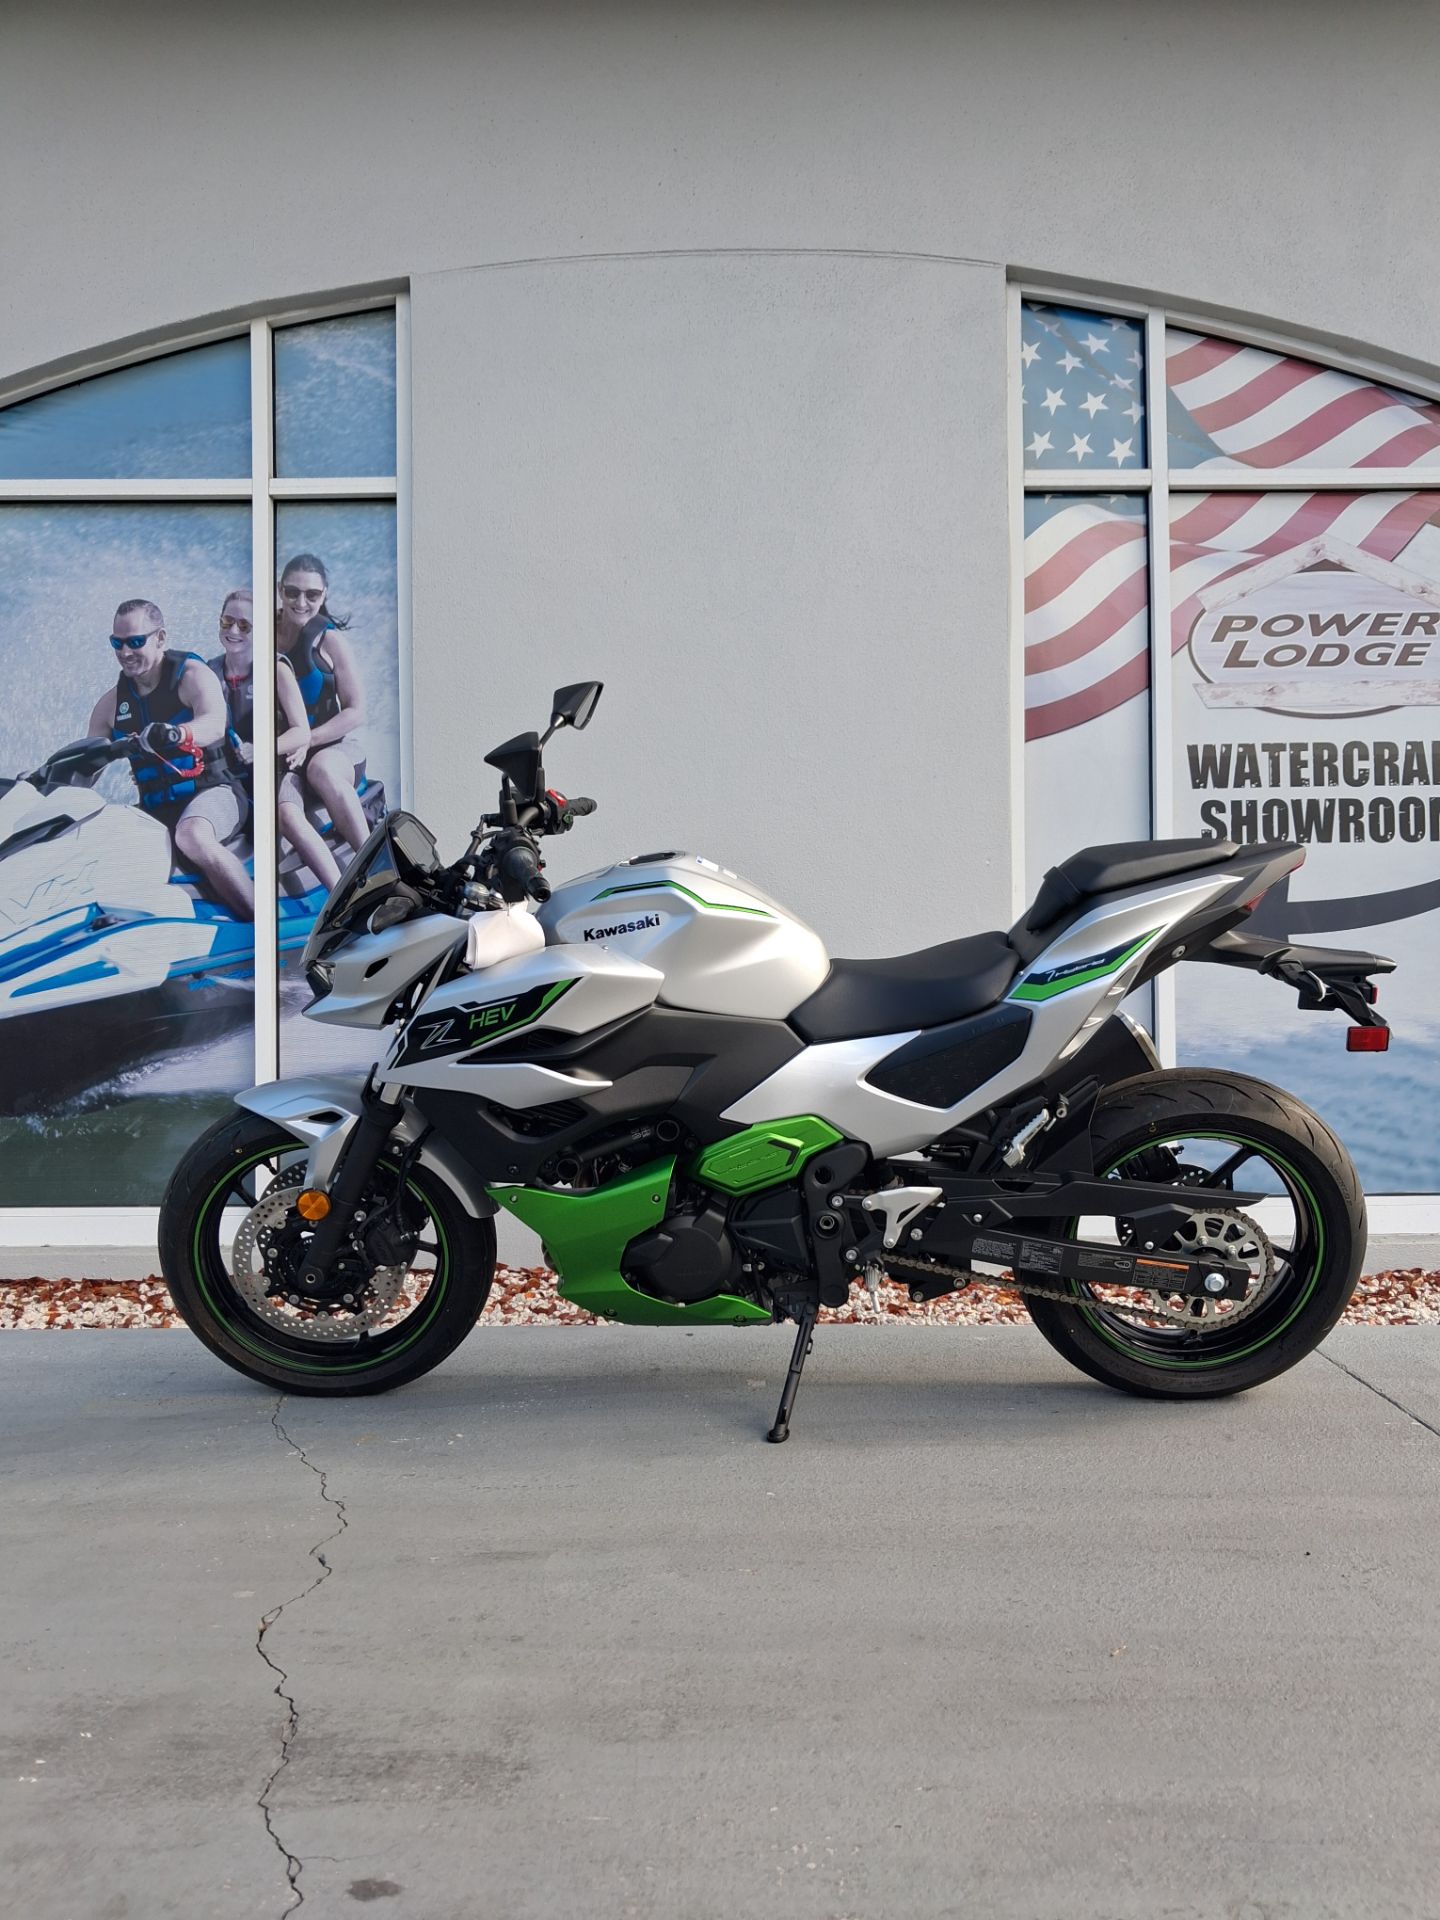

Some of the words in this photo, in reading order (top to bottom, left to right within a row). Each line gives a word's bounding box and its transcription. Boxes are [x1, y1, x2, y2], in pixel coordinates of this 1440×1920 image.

[1210, 612, 1440, 643] POWER
[1222, 639, 1433, 668] LODGE
[1200, 796, 1440, 845] SHOWROO
[583, 913, 660, 942] Kawasaki
[468, 1003, 517, 1030] HEV
